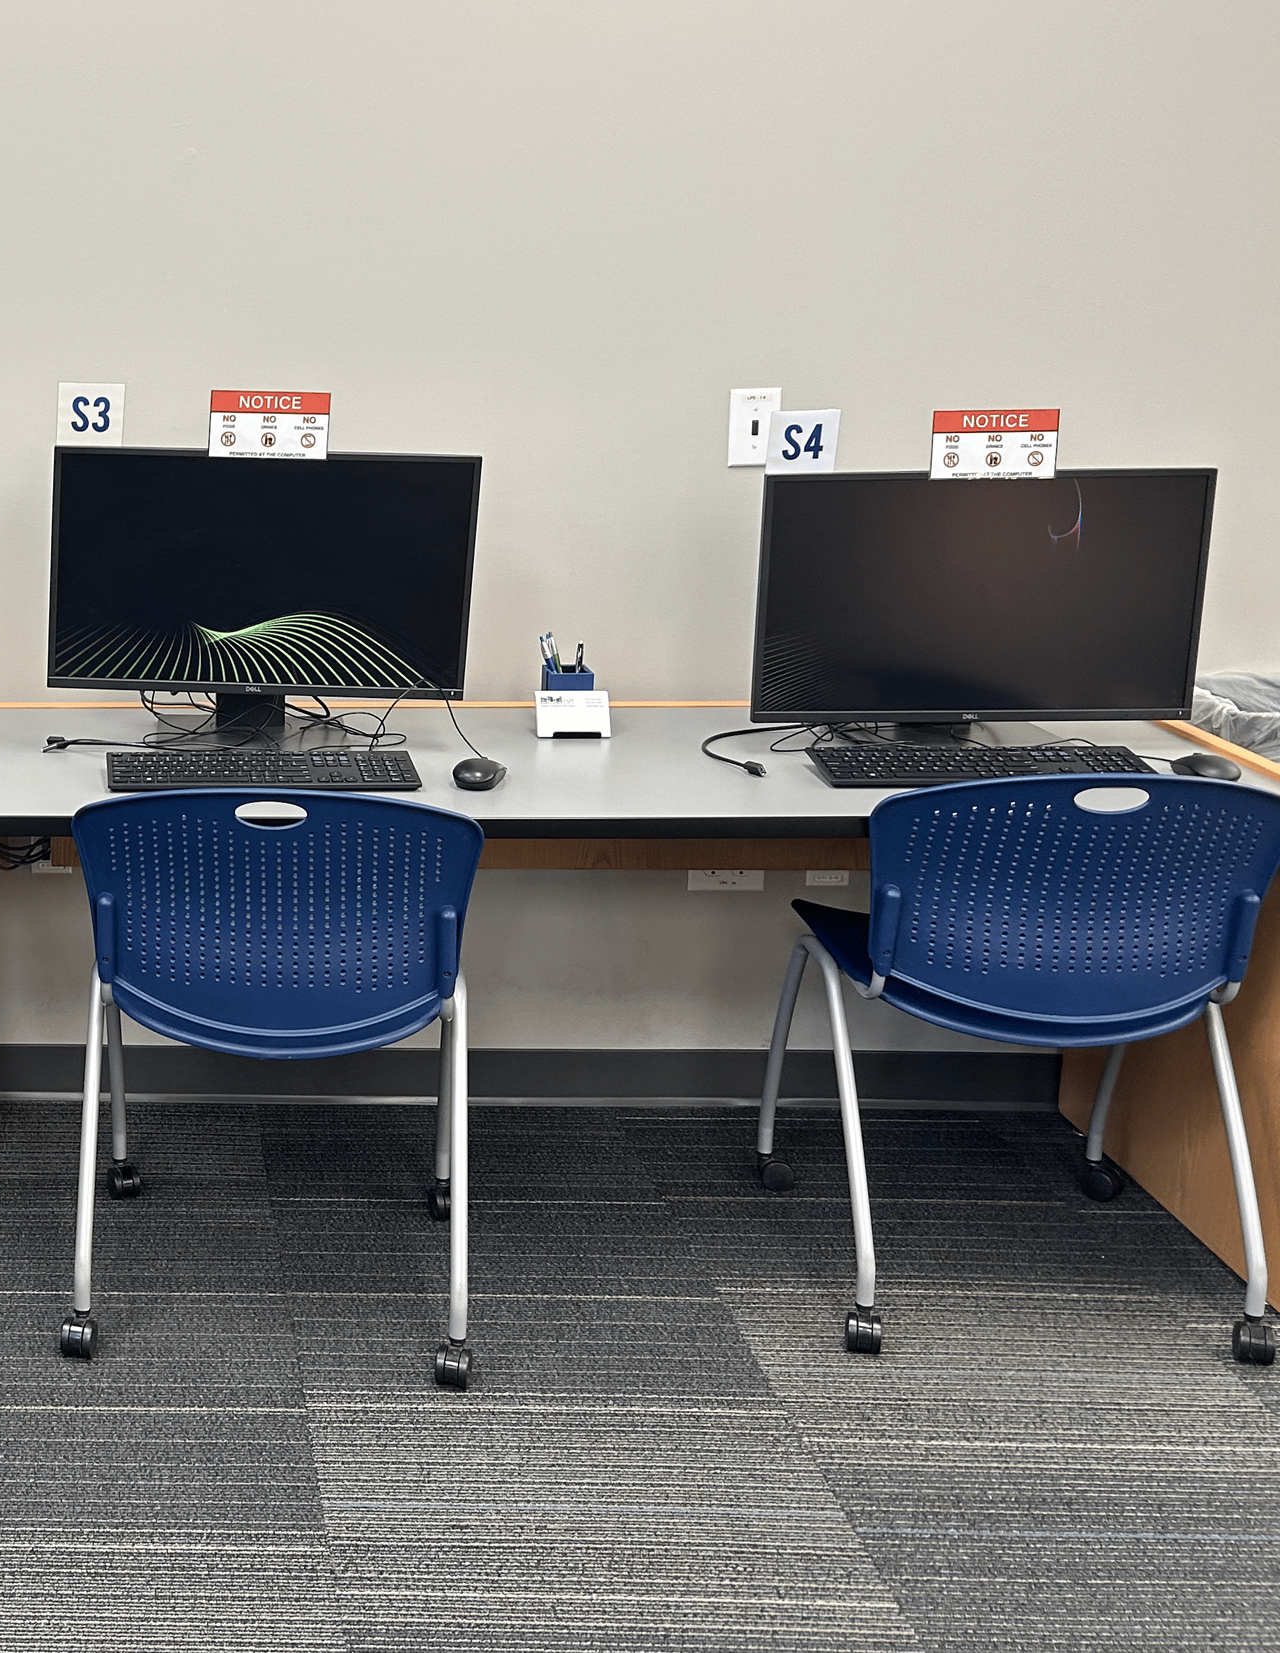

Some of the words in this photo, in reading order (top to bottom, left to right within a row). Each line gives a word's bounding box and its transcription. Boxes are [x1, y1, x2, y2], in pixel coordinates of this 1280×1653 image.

[238, 395, 302, 410] NOTICE
[71, 396, 110, 432] S3
[222, 414, 236, 423] NO
[262, 415, 277, 423] NO
[302, 416, 317, 424] NO
[962, 414, 1029, 429] NOTICE
[782, 423, 824, 460] S4
[945, 435, 960, 443] NO
[987, 434, 1003, 442] NO
[1029, 433, 1044, 442] NO
[245, 685, 262, 693] DELL
